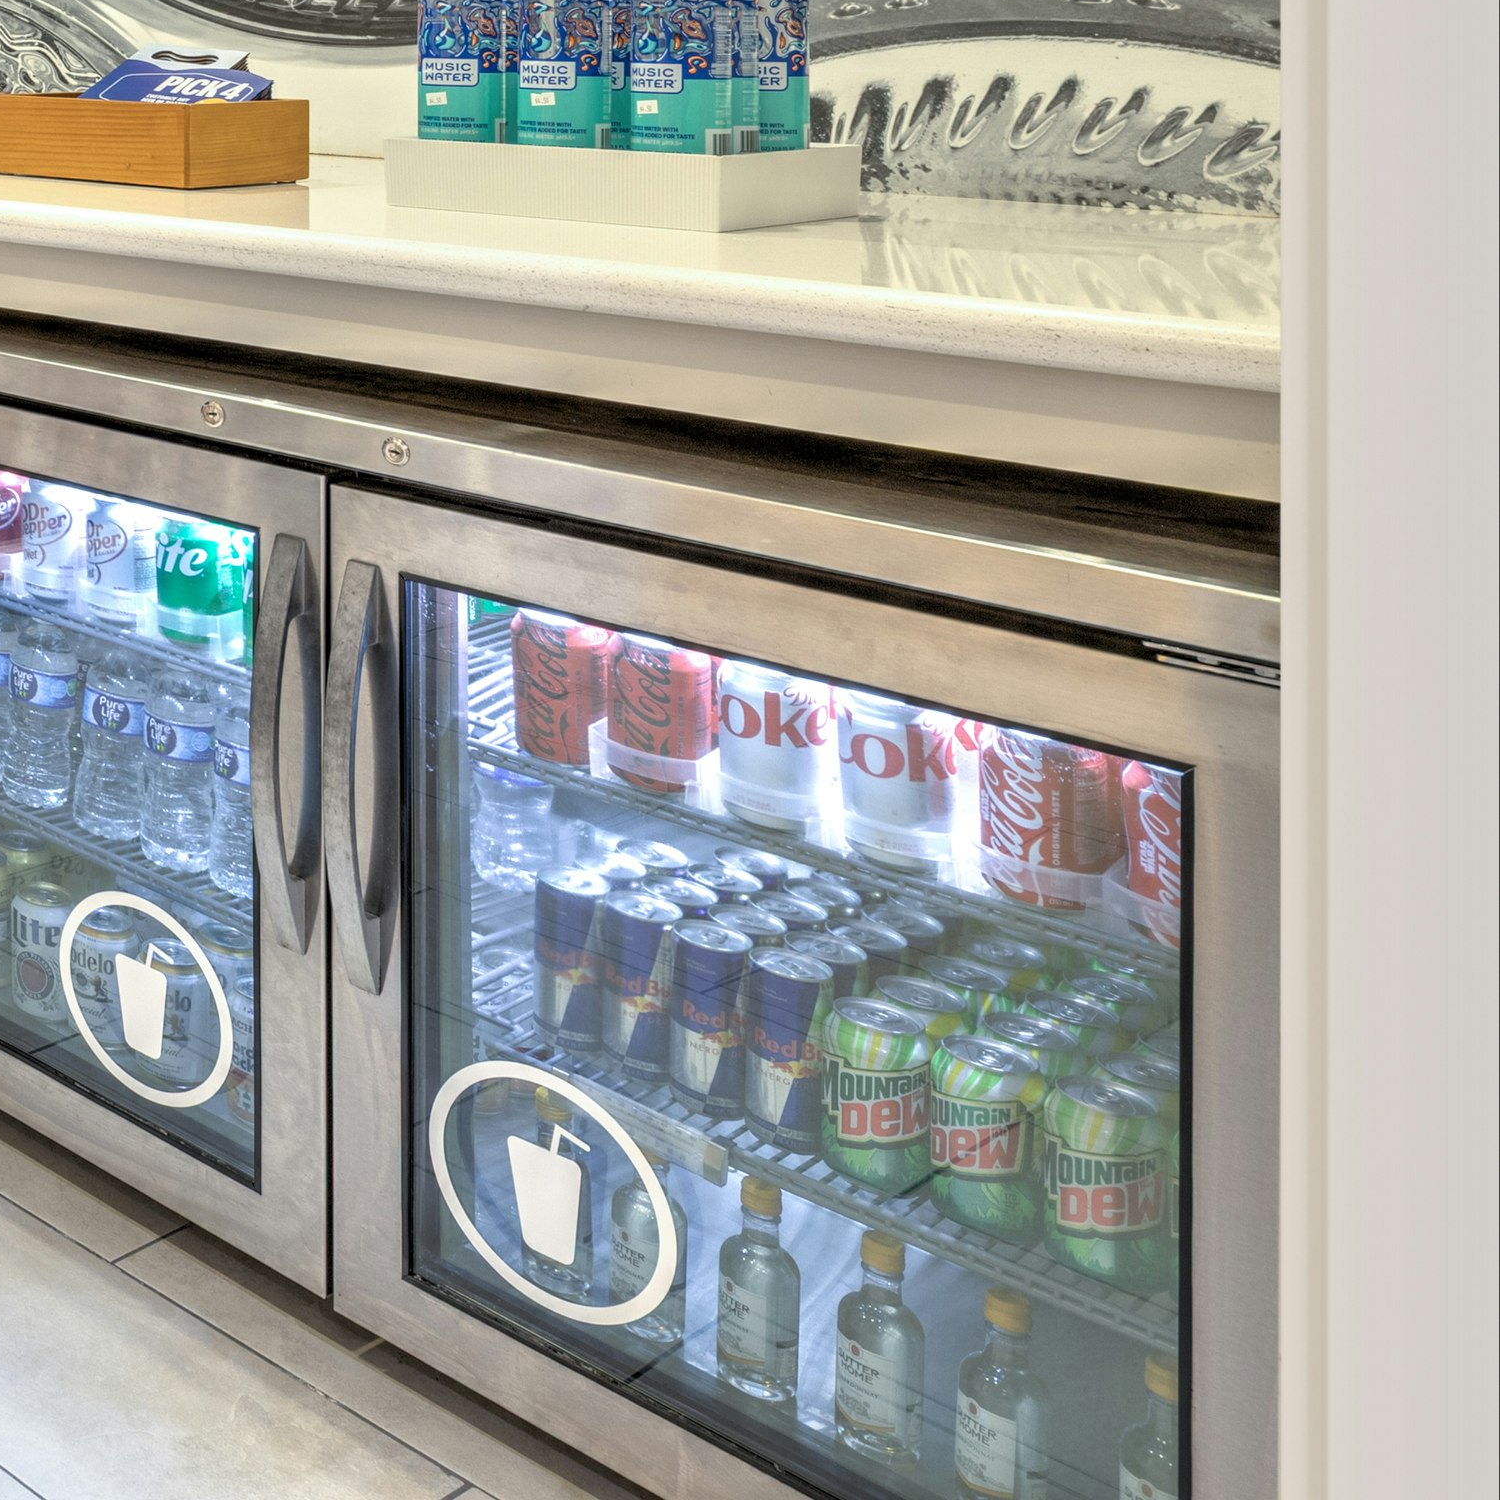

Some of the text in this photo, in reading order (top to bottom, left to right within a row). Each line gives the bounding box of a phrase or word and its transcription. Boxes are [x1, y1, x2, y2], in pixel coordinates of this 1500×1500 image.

[425, 62, 471, 72] MUSIC
[425, 73, 473, 83] WATER
[632, 67, 674, 77] MUSIC
[153, 76, 249, 100] PICK 4
[632, 79, 675, 88] WATER
[99, 696, 125, 713] Pure
[101, 707, 121, 722] Life
[1053, 823, 1061, 866] ORIGINAL
[13, 906, 61, 948] Lite
[71, 946, 115, 975] odelo
[683, 1000, 727, 1030] Red
[754, 1027, 797, 1059] Red
[839, 1346, 881, 1380] SUTTER
[841, 1360, 875, 1387] HOME
